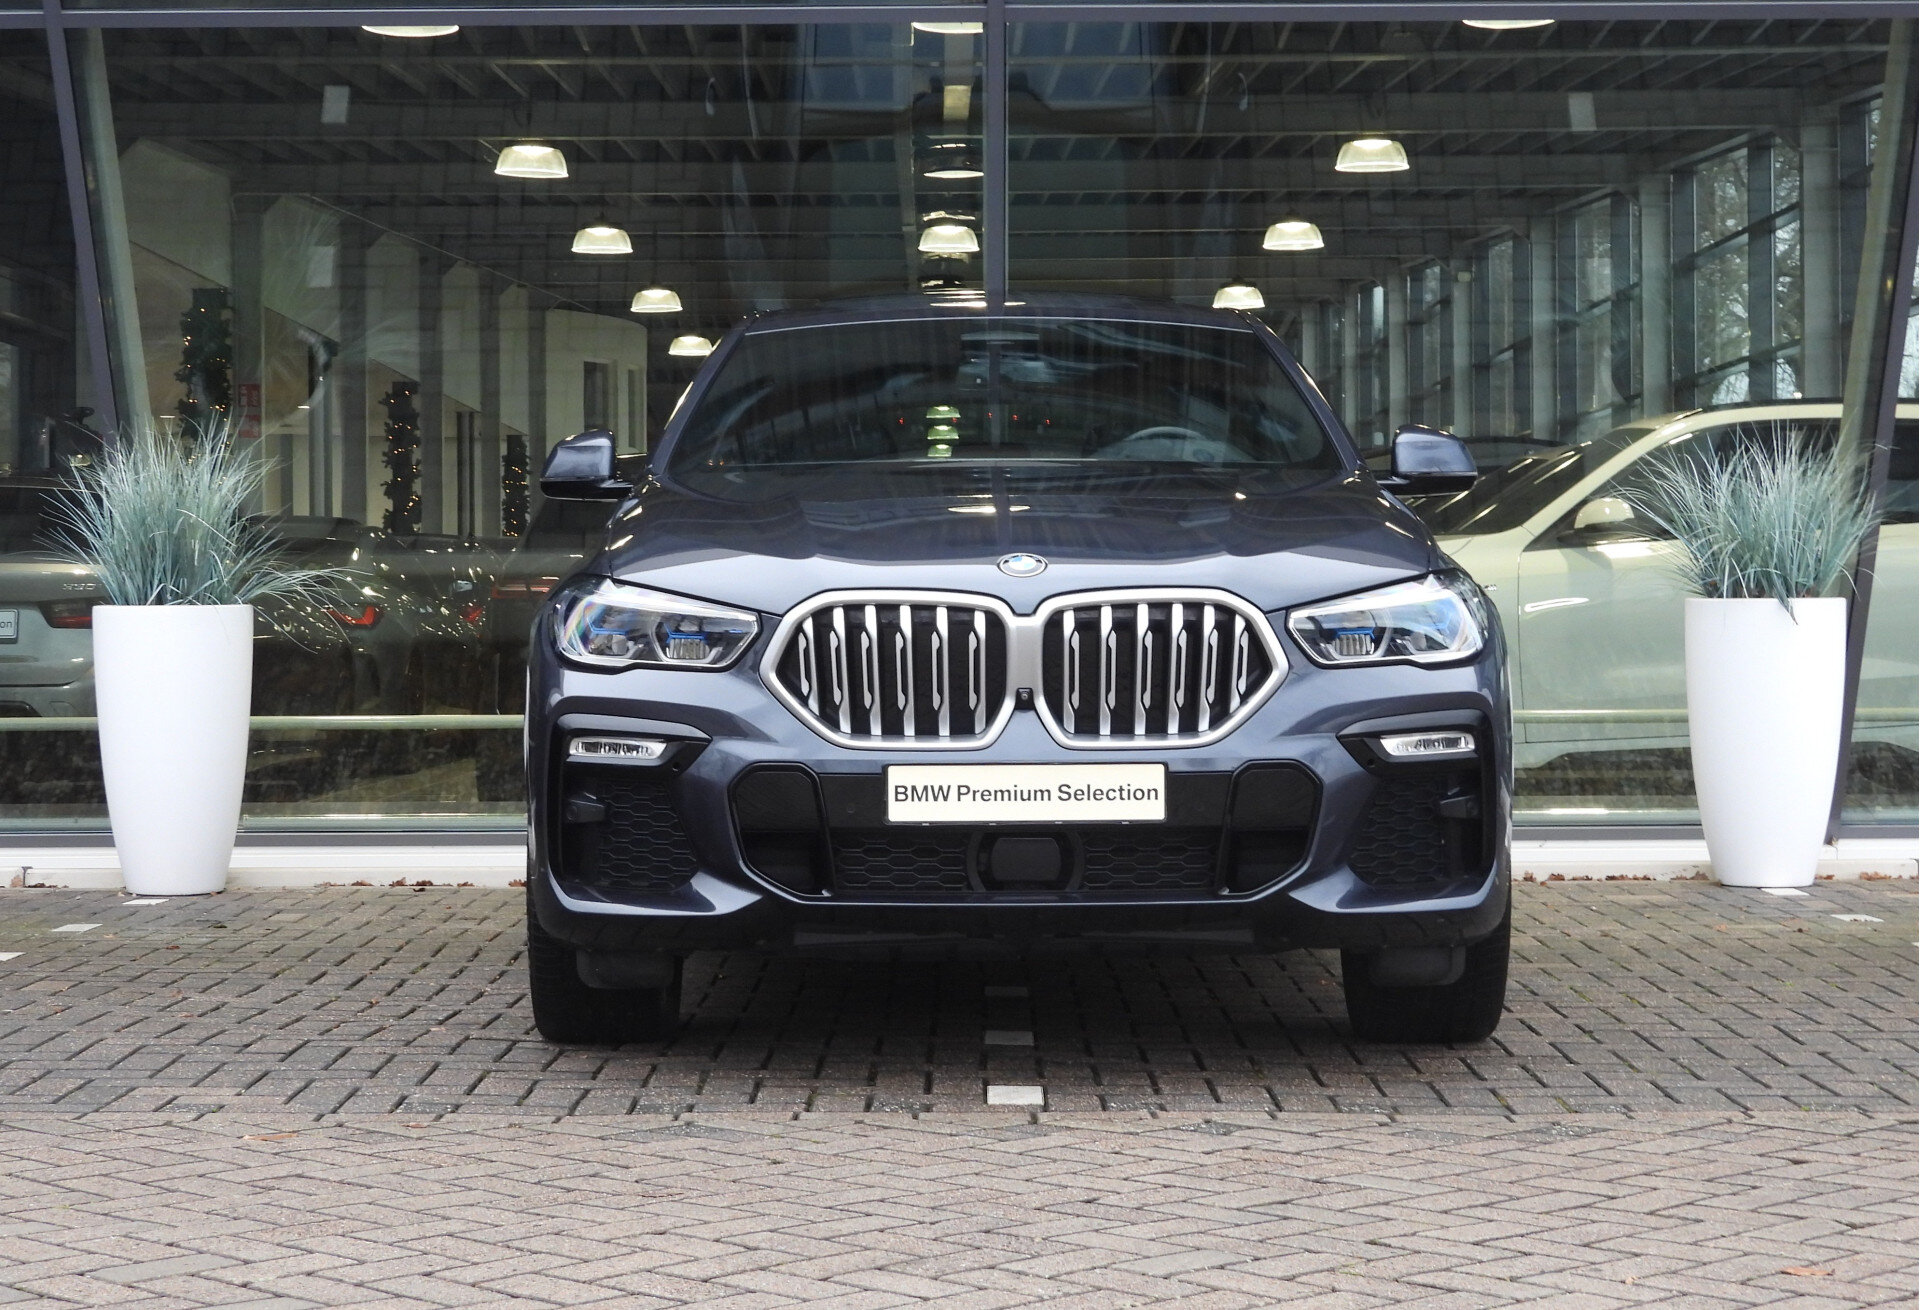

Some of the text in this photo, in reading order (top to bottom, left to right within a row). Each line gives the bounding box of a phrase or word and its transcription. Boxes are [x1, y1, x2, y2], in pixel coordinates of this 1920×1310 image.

[894, 783, 1159, 802] BMW Premium Selection
